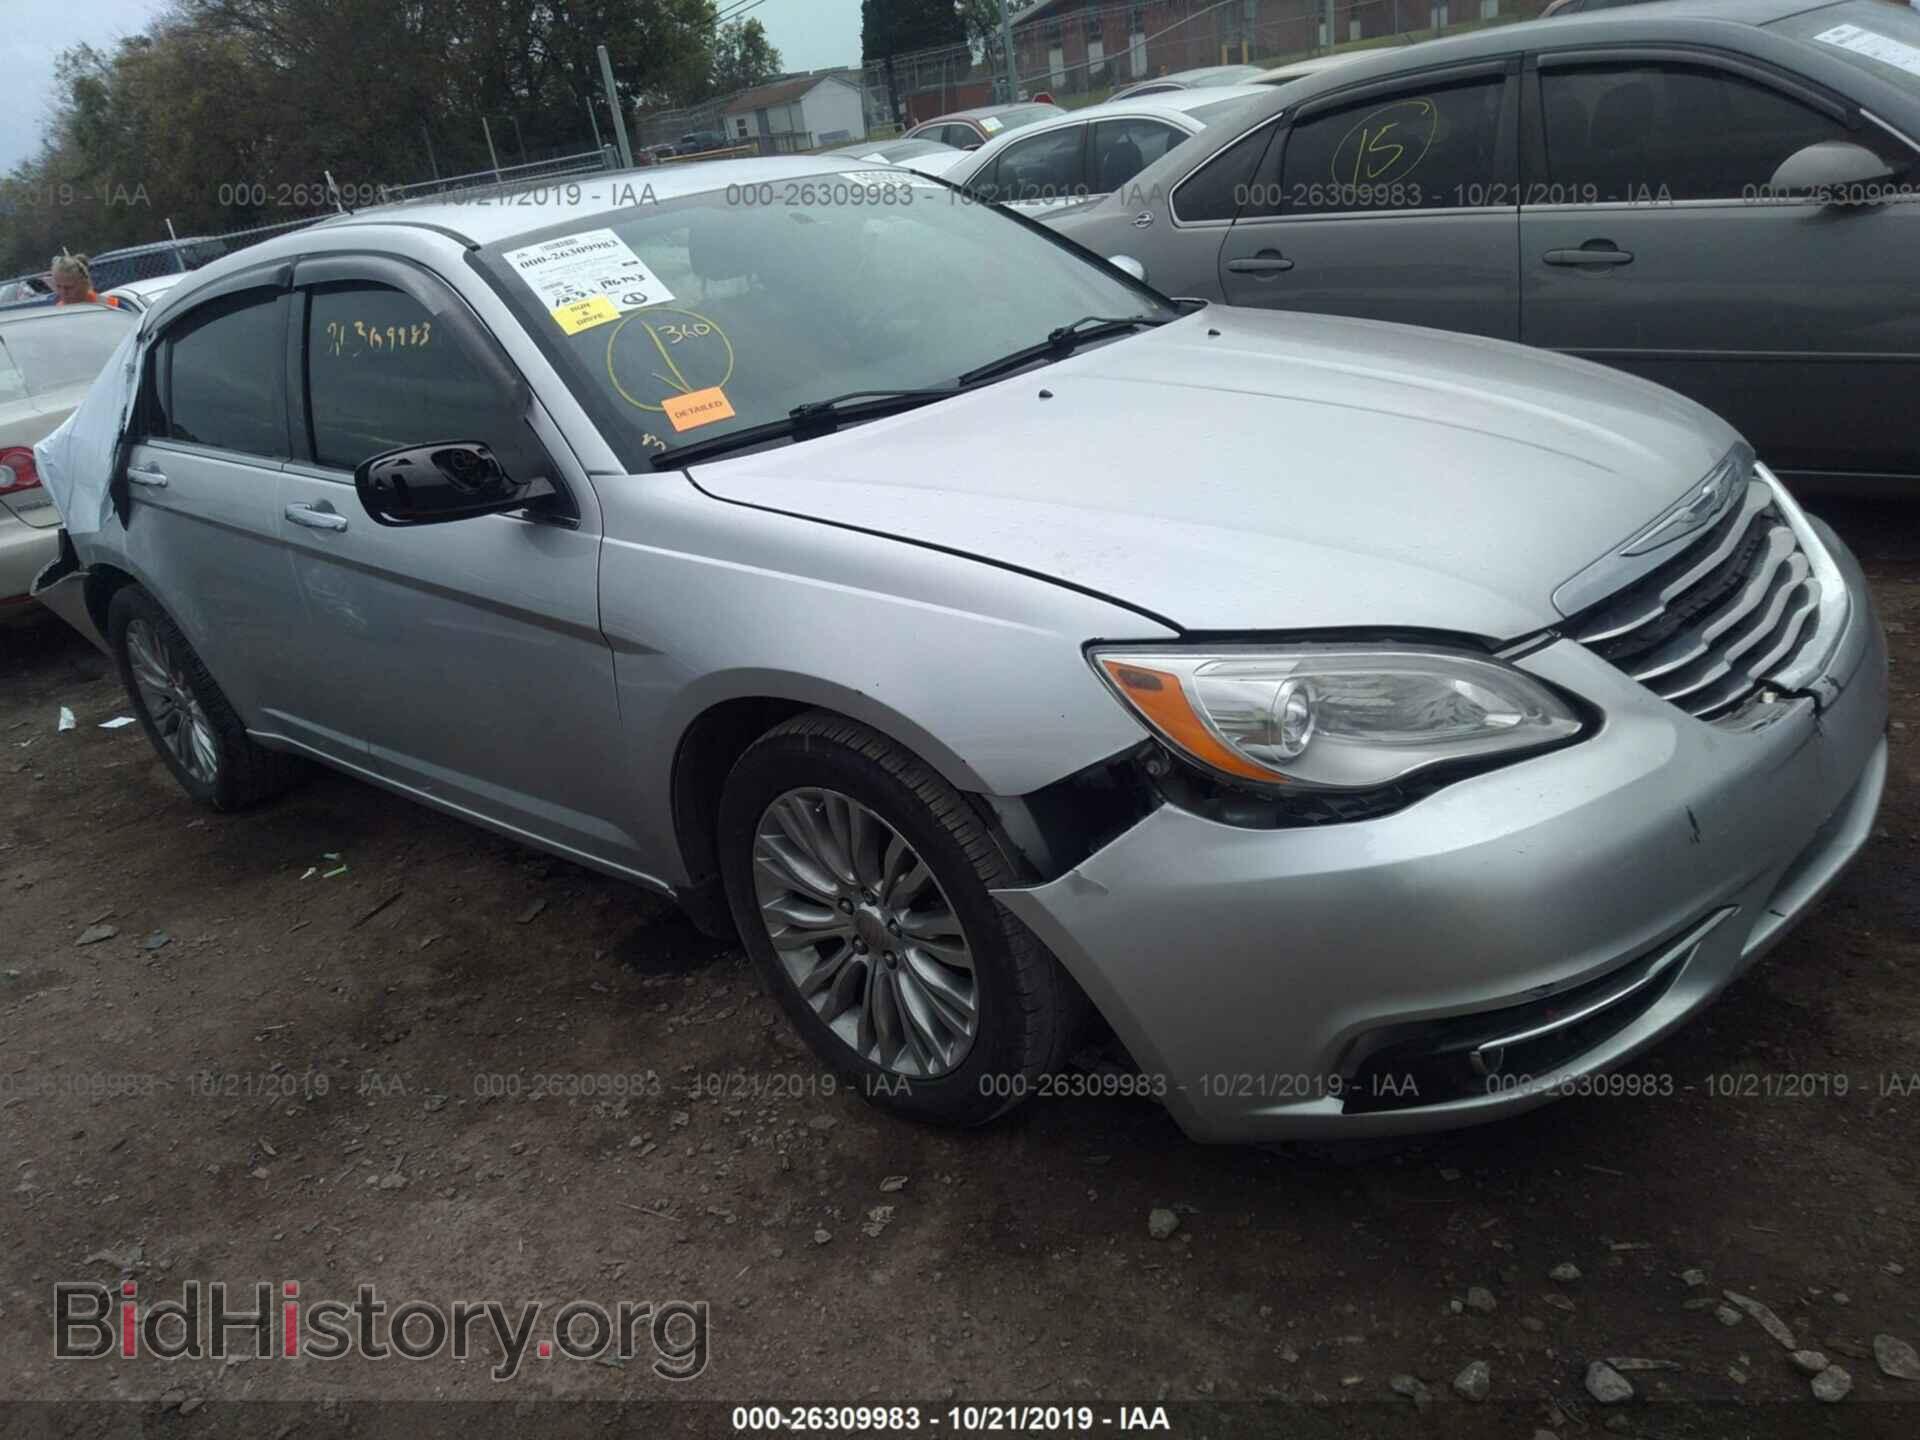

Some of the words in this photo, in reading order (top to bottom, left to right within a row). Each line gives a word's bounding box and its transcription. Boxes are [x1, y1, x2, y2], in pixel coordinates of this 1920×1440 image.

[1352, 123, 1404, 190] 15
[658, 322, 712, 344] 360
[674, 399, 724, 419] DETAILED
